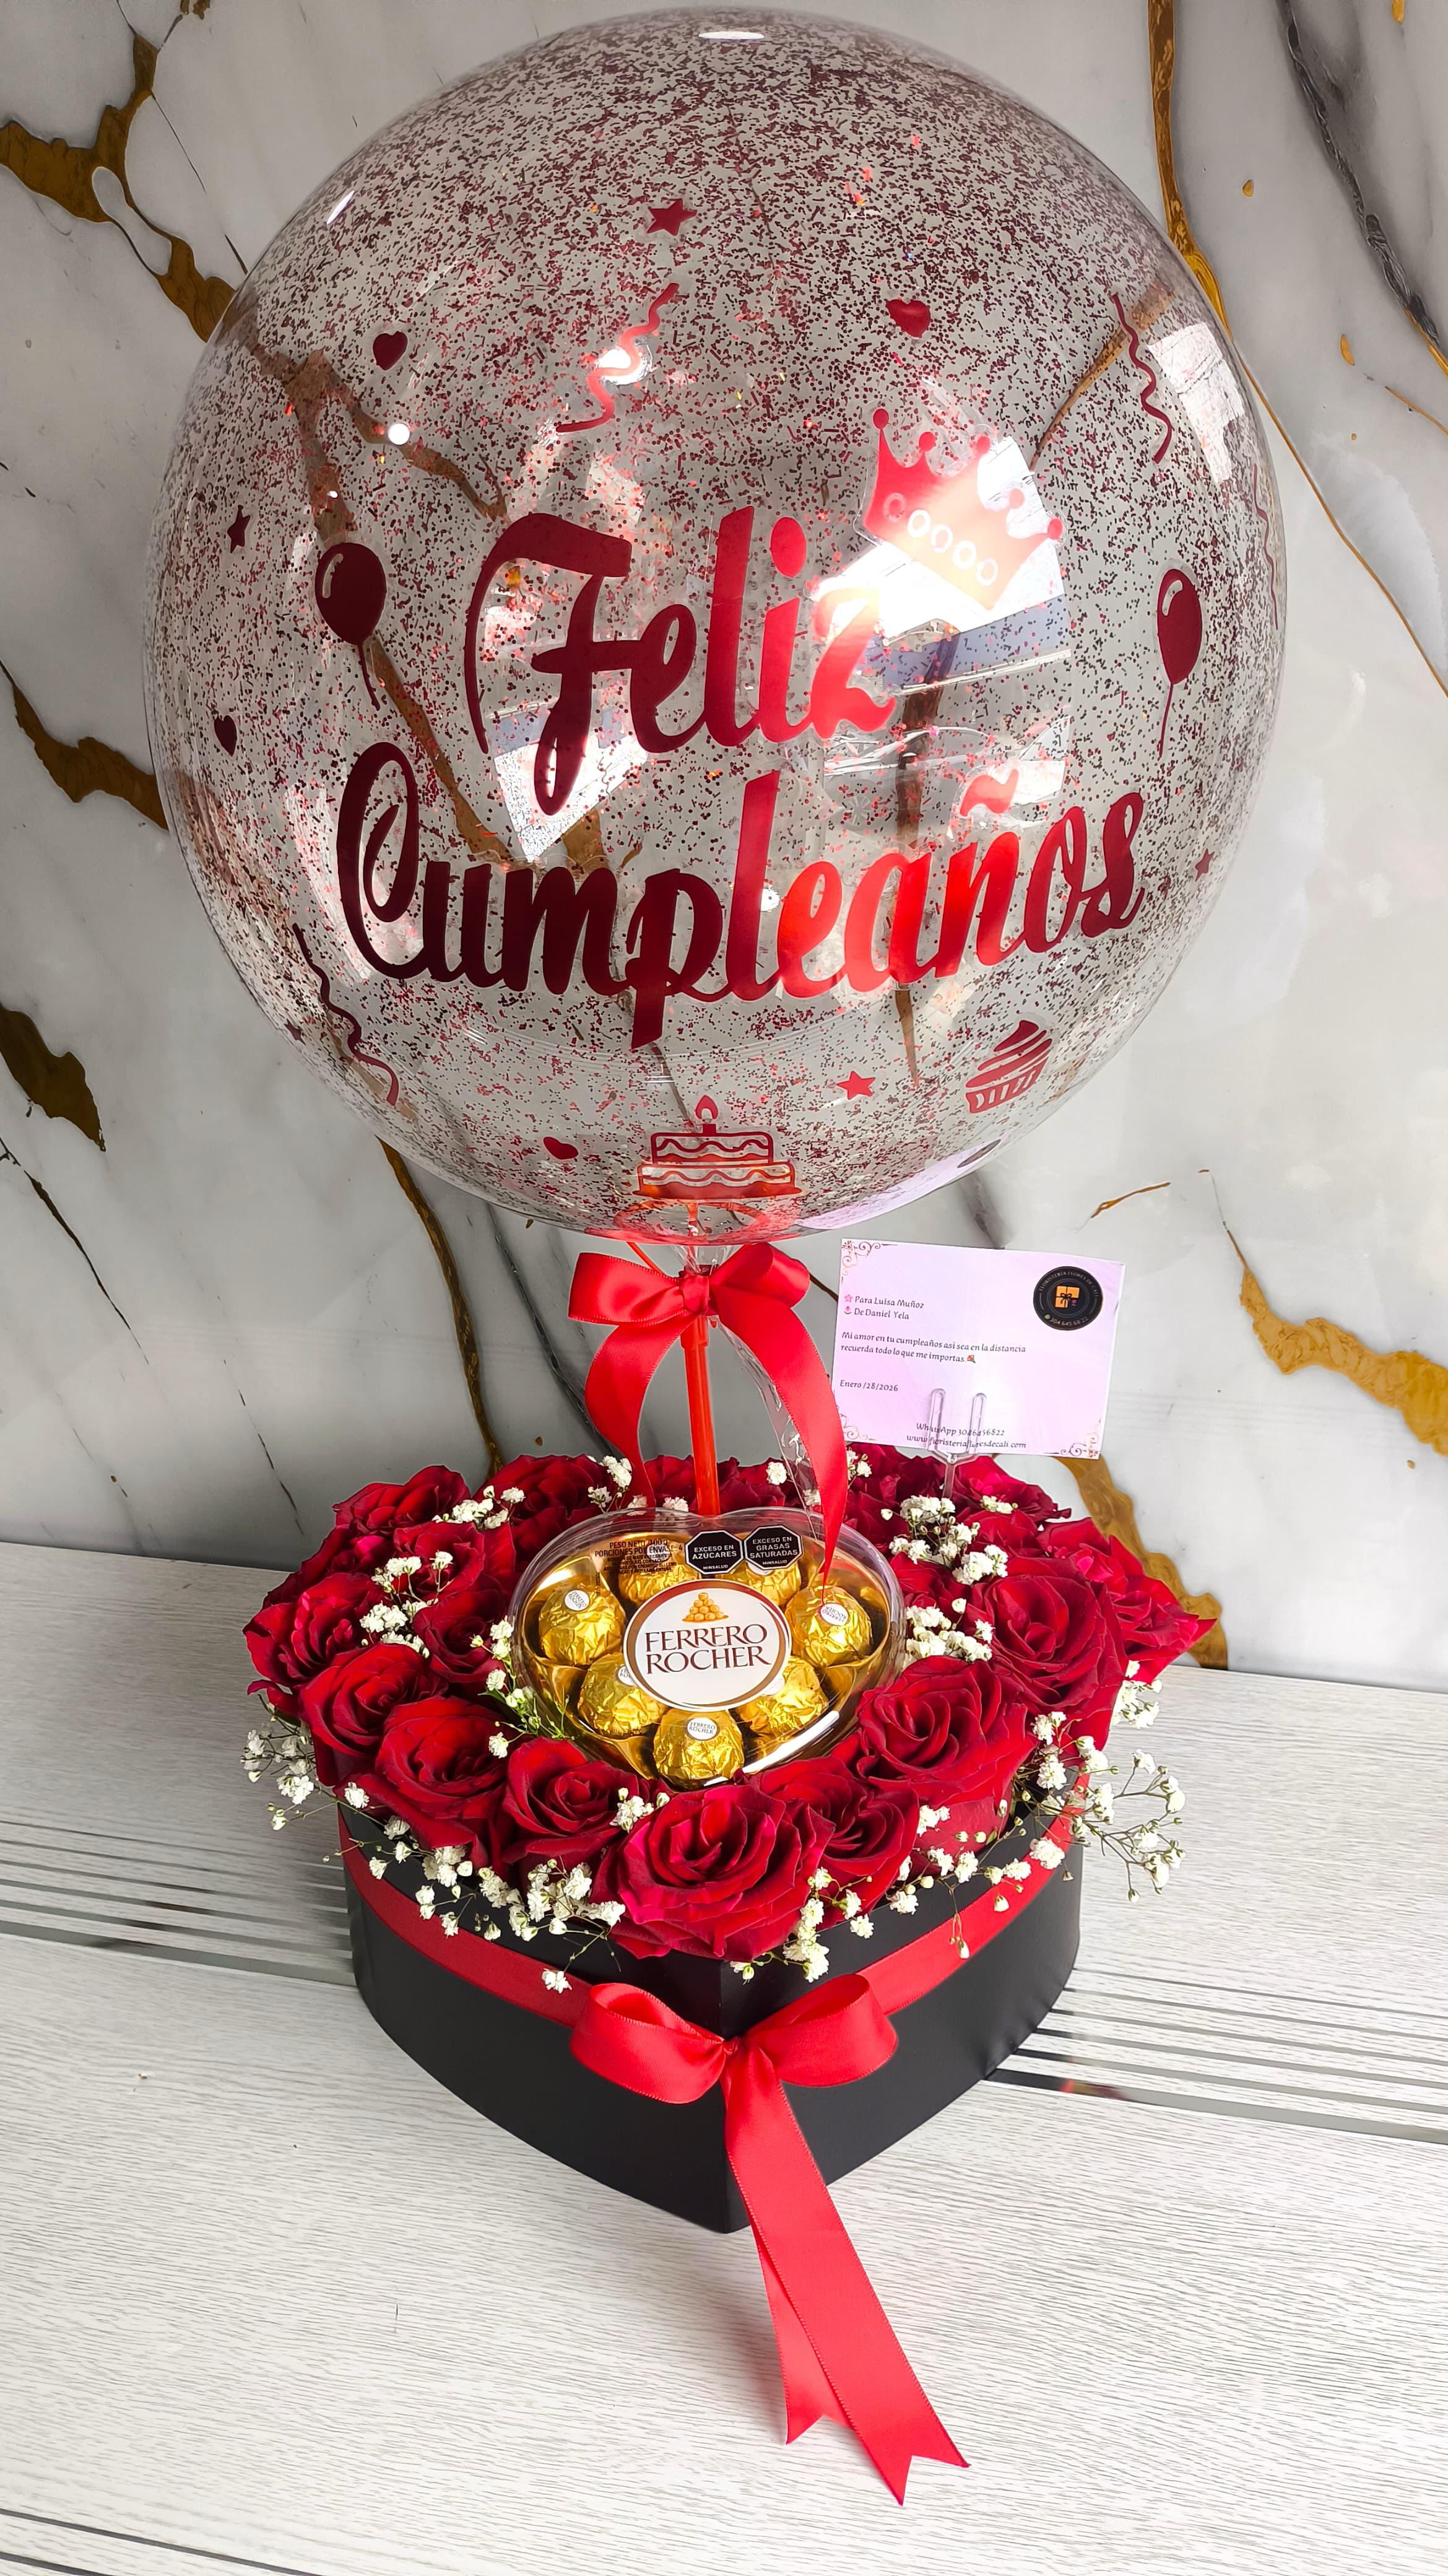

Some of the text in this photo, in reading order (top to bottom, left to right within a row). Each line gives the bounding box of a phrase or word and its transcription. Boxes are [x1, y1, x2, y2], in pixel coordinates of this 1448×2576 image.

[464, 506, 896, 815] Feliz
[337, 767, 1144, 1048] Cumpleaños
[855, 1295, 924, 1308] Para Luisa Muñoz
[865, 1308, 890, 1318] Daniel
[893, 1311, 909, 1320] Yela
[841, 1345, 874, 1353] recuerda
[875, 1346, 891, 1354] todo
[893, 1347, 900, 1355] lo
[896, 1338, 942, 1348] cumpleaños
[981, 1343, 988, 1351] la
[990, 1344, 1026, 1352] distancia
[840, 1379, 898, 1391] Enero /28/2026
[916, 1422, 956, 1436] WhatsApp
[609, 1541, 626, 1549] PESO
[628, 1540, 645, 1548] NETO
[756, 1543, 791, 1551] GRASAS
[595, 1548, 633, 1557] PORCIONES
[692, 1550, 737, 1560] AZÚCARES
[750, 1549, 798, 1559] SATURADAS
[645, 1624, 768, 1652] FERRERO
[646, 1645, 772, 1674] ROCHER
[689, 1721, 716, 1730] FERRERO
[689, 1726, 714, 1734] ROCHER
